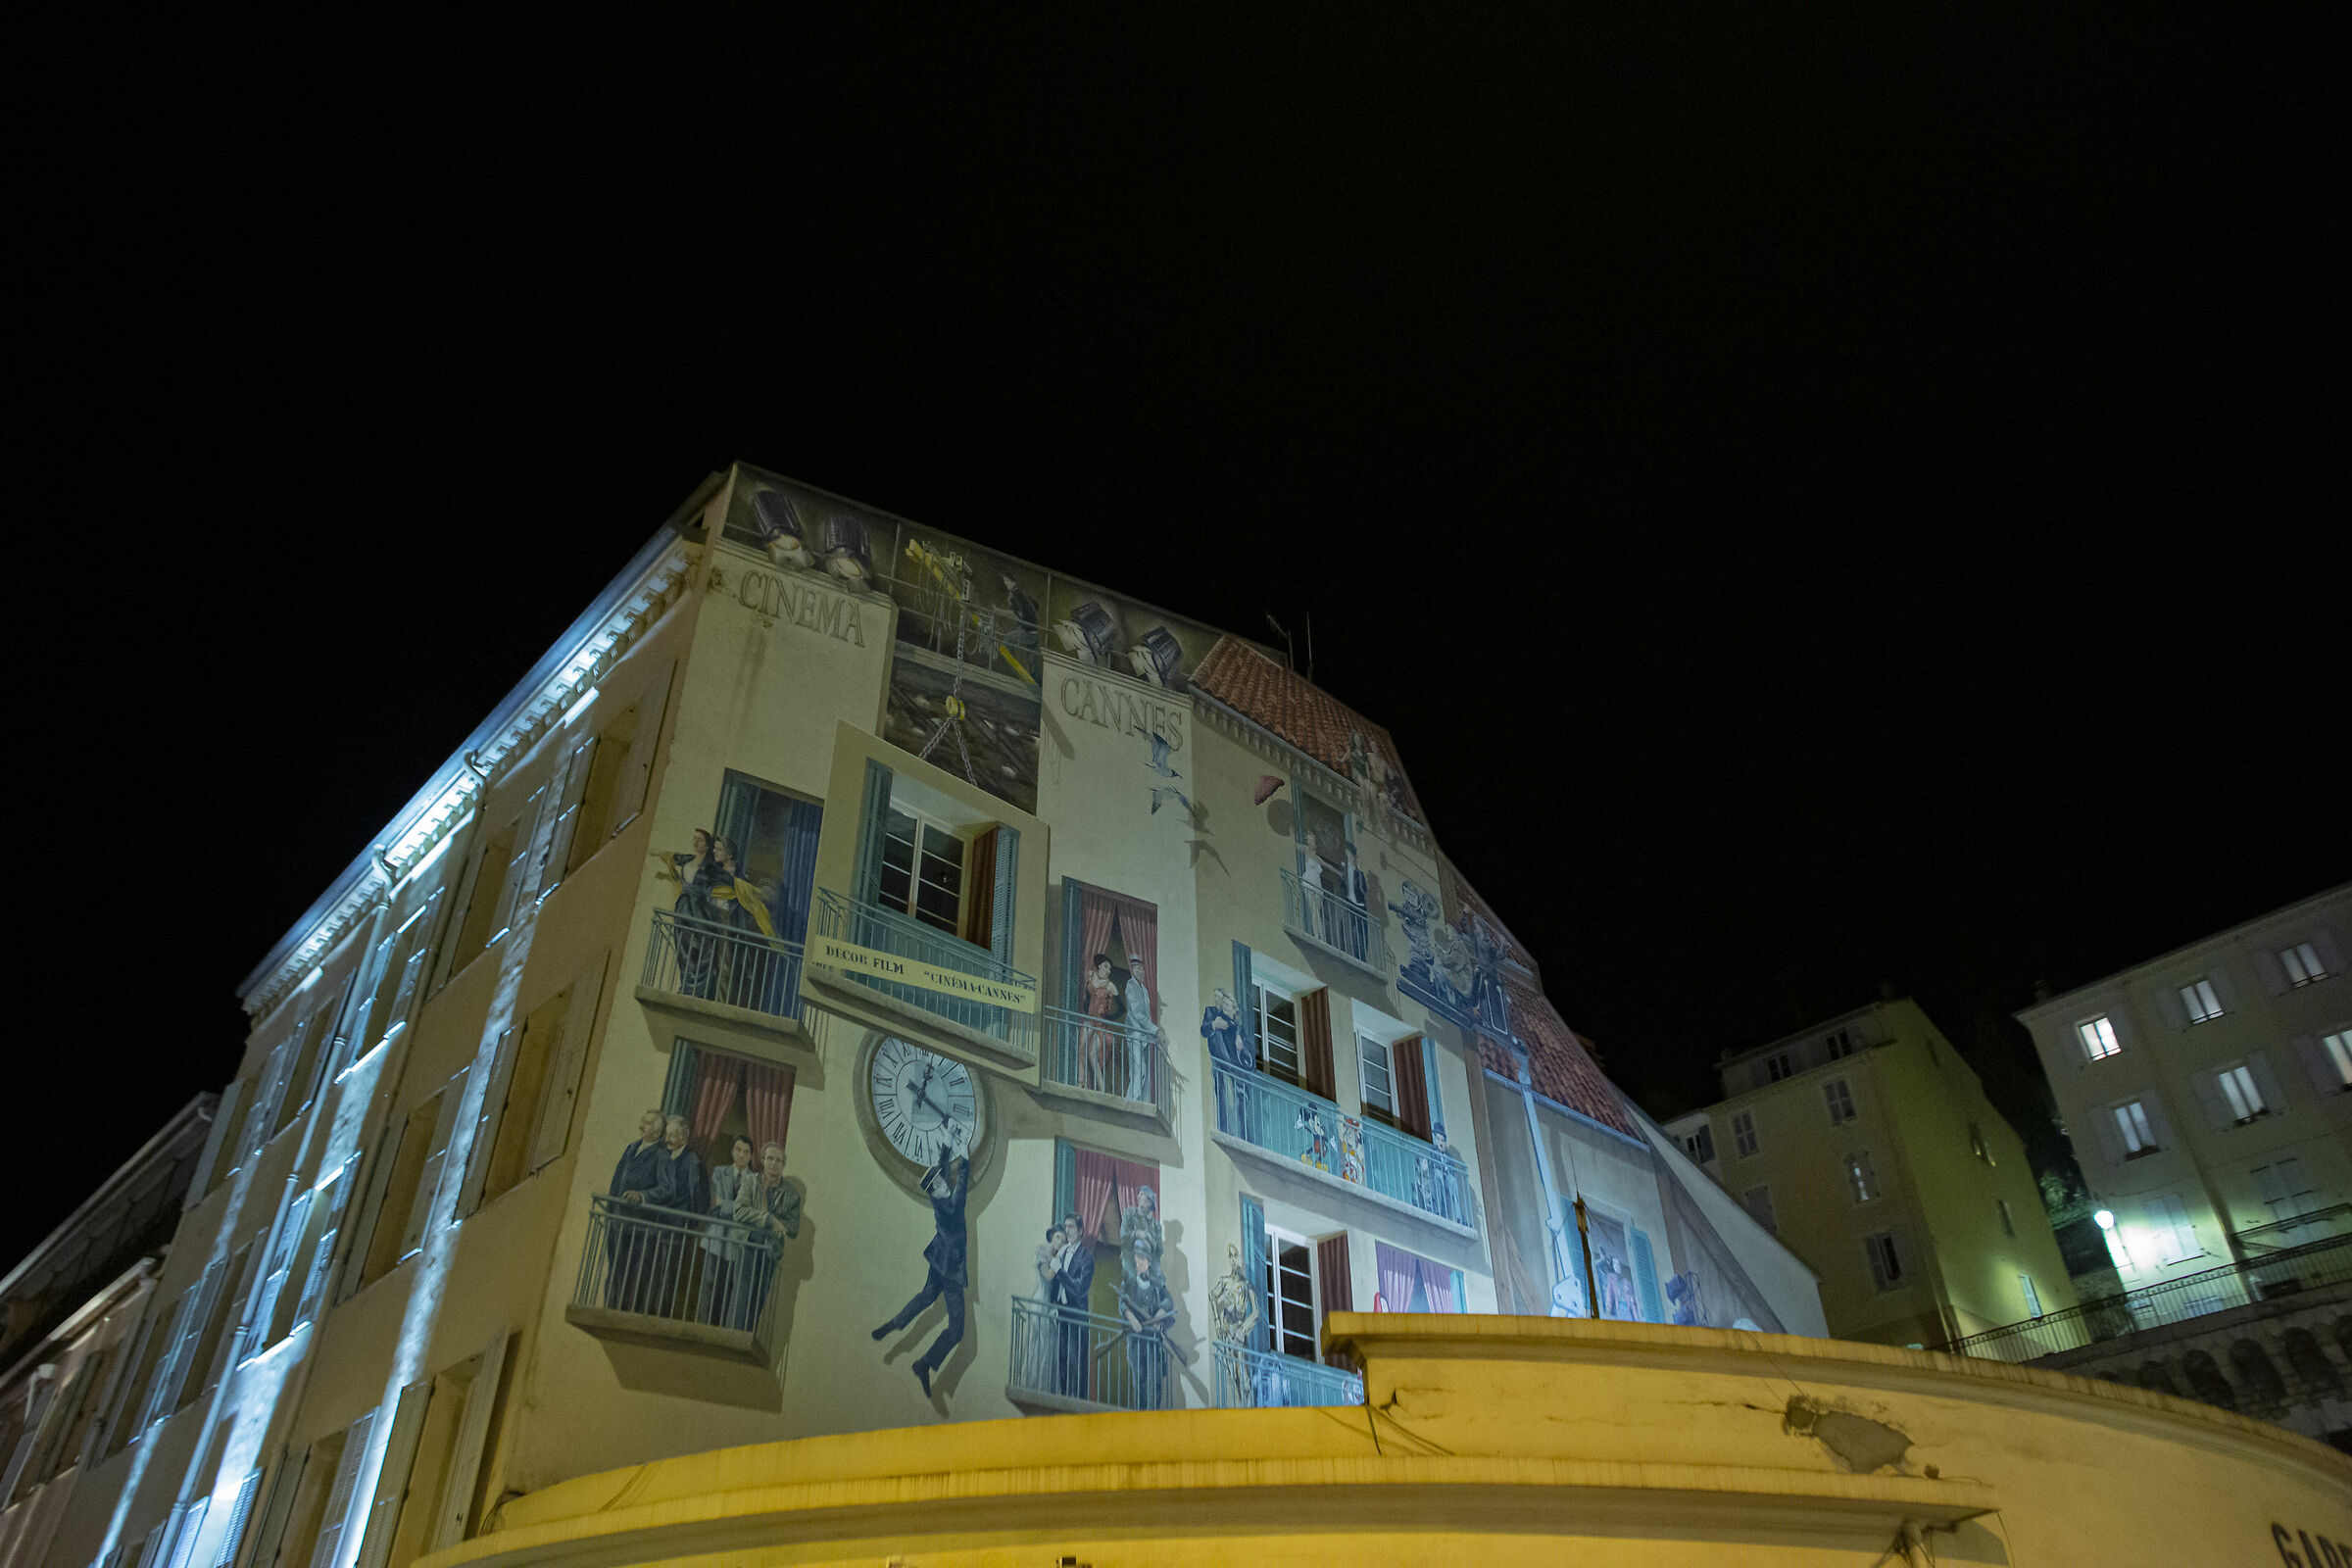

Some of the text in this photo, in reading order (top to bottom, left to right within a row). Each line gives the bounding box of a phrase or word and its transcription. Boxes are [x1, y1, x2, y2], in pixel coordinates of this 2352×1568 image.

[739, 570, 864, 648] CINEMA
[1060, 676, 1183, 753] CANNES
[873, 956, 904, 975] FILM
